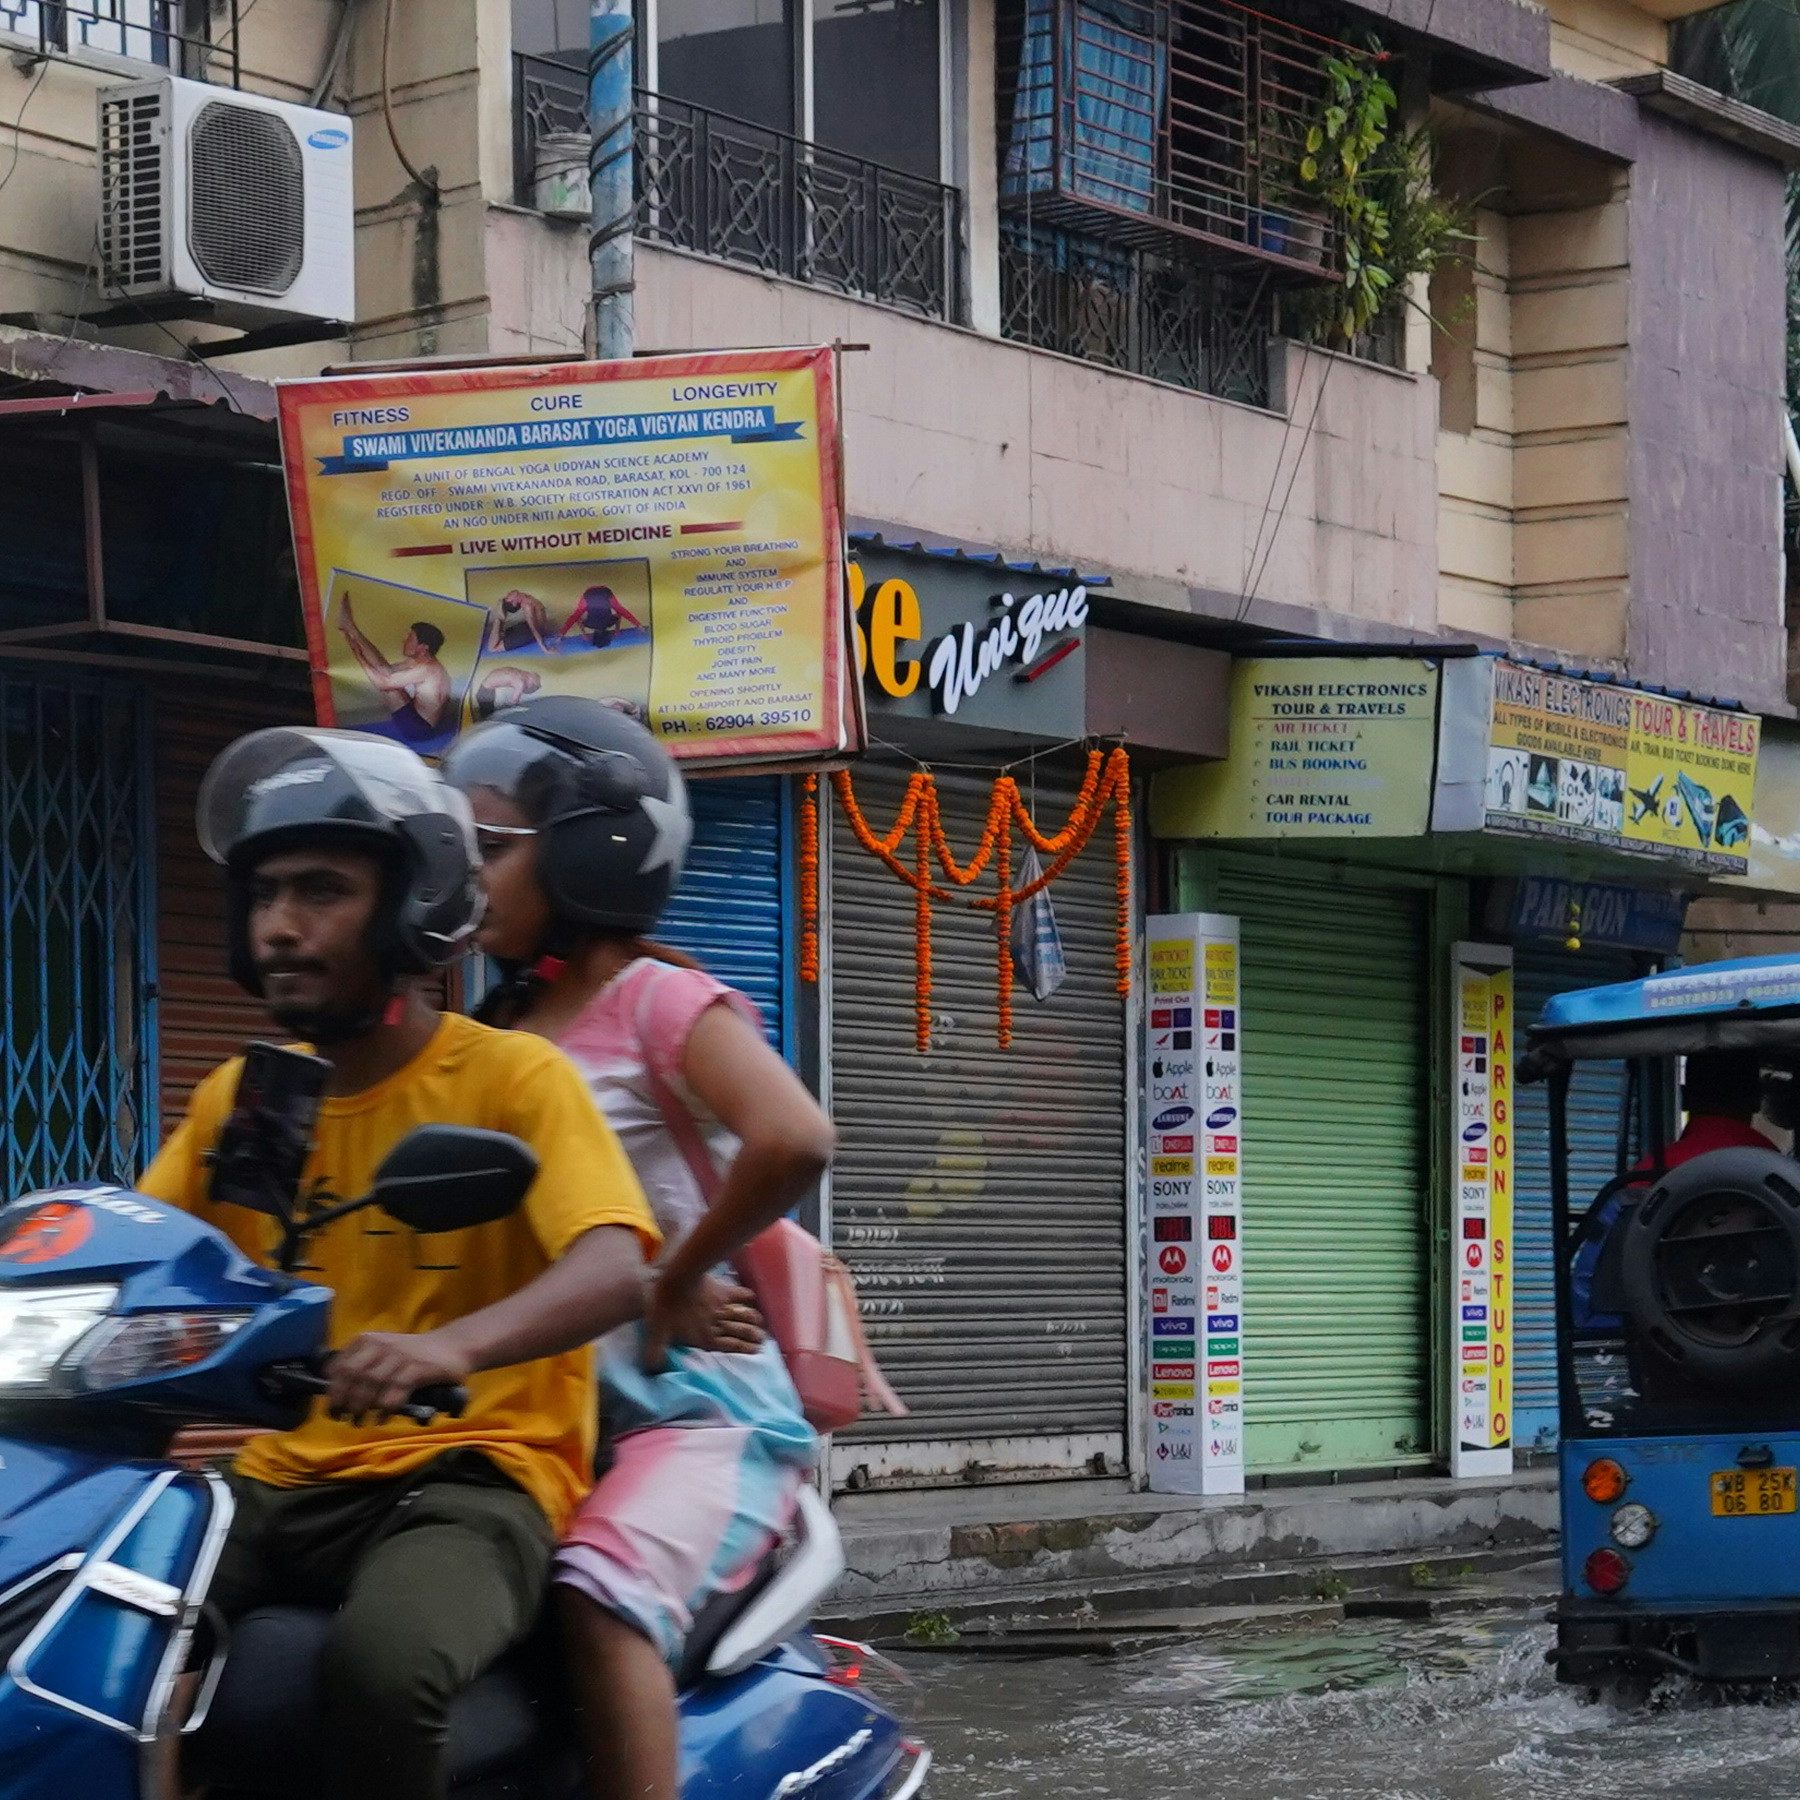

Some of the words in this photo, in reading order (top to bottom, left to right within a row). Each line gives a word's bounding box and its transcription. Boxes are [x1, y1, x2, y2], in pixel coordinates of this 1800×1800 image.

[333, 407, 410, 427] FITNESS
[531, 394, 583, 411] CURE
[673, 382, 778, 401] LONGEVITY
[353, 433, 407, 458] SWAMI
[411, 426, 518, 454] VIVEKANANDA
[521, 421, 591, 445] BARASAT
[594, 418, 638, 440] YOGA
[641, 414, 698, 436] VIGYAN
[703, 409, 766, 432] KENDRA
[425, 470, 451, 482] UNIT
[455, 469, 469, 480] OF
[472, 465, 516, 479] BENGAL
[519, 463, 550, 475] YOGA
[554, 459, 600, 473] UDDYAN
[604, 455, 650, 469] SCIENCE
[653, 451, 709, 465] ACADEMY
[448, 483, 487, 497] SWAMI
[491, 477, 571, 494] VIVEKANANDA
[670, 468, 690, 481] KOL
[702, 466, 722, 478] 700
[726, 464, 746, 476] 124
[377, 502, 442, 518] REGISTERED
[521, 493, 565, 507] SOCIETY
[570, 487, 649, 504] REGISTRATION
[652, 486, 673, 497] ACT
[677, 484, 702, 496] XXVI
[707, 482, 720, 493] OF
[725, 480, 751, 492] 1961
[443, 517, 459, 529] AN
[463, 515, 487, 528] NGO
[491, 512, 529, 525] UNDER
[532, 510, 554, 522] NITI
[636, 503, 649, 515] OF
[654, 500, 686, 513] INDIA
[460, 539, 497, 555] LIVE
[502, 532, 582, 551] WITHOUT
[587, 525, 672, 544] MEDICINE
[671, 548, 710, 560] STRONG
[713, 545, 741, 556] YOUR
[743, 540, 798, 554] BREATHING
[725, 558, 747, 568] AND
[696, 571, 735, 583] IMMUNE
[738, 568, 777, 580] SYSTEM
[684, 584, 734, 596] REGULATE
[737, 582, 764, 592] YOUR
[728, 597, 749, 606] AND
[688, 609, 736, 622] DIGESTIVE
[740, 605, 788, 617] FUNCTION
[704, 622, 737, 633] BLOOD
[740, 619, 771, 630] SUGAR
[693, 635, 734, 647] THYROID
[737, 630, 783, 643] PROBLEM
[717, 645, 756, 656] OBESITY
[929, 585, 1089, 714] Unique
[712, 658, 739, 668] JOINT
[741, 656, 763, 665] PAIN
[696, 671, 717, 681] AND
[719, 669, 747, 679] MANY
[749, 667, 776, 676] MORE
[689, 687, 735, 698] OPENING
[737, 683, 782, 694] SHORTLY
[1254, 684, 1313, 697] VIKASH
[1319, 683, 1427, 696] ELECTRONICS
[680, 704, 695, 713] NO
[698, 700, 740, 711] AIRPORT
[744, 697, 765, 707] AND
[767, 693, 813, 705] BARASAT
[1495, 670, 1541, 708] VIKASH
[1545, 679, 1631, 727] ELECTRONICS
[1272, 703, 1315, 715] TOUR
[1337, 703, 1406, 715] TRAVELS
[662, 719, 692, 734] PH.
[706, 714, 755, 730] 62904
[760, 709, 811, 726] 39510
[1273, 723, 1295, 734] AIR
[1301, 722, 1349, 734] TICKET
[1635, 699, 1673, 738] TOUR
[1693, 711, 1756, 754] TRAVELS
[1271, 740, 1300, 752] RAIL
[1307, 741, 1356, 752] TICKET
[1269, 758, 1298, 770] BUS
[1302, 759, 1367, 770] BOOKING
[1266, 794, 1295, 806] CAR
[1300, 795, 1351, 806] RENTAL
[1266, 812, 1303, 823] TOUR
[1308, 813, 1373, 825] PACKAGE
[1166, 1060, 1193, 1079] Apple
[1216, 1060, 1237, 1079] Apple
[1154, 1160, 1190, 1174] realme
[1153, 1181, 1192, 1196] SONY
[1207, 1180, 1235, 1195] SONY
[1161, 1321, 1188, 1331] vivo
[1212, 1318, 1234, 1329] vivo
[1155, 1366, 1192, 1379] Lenovo
[1209, 1364, 1238, 1376] Lenovo
[1723, 1494, 1746, 1513] 06
[1759, 1492, 1783, 1511] 80
